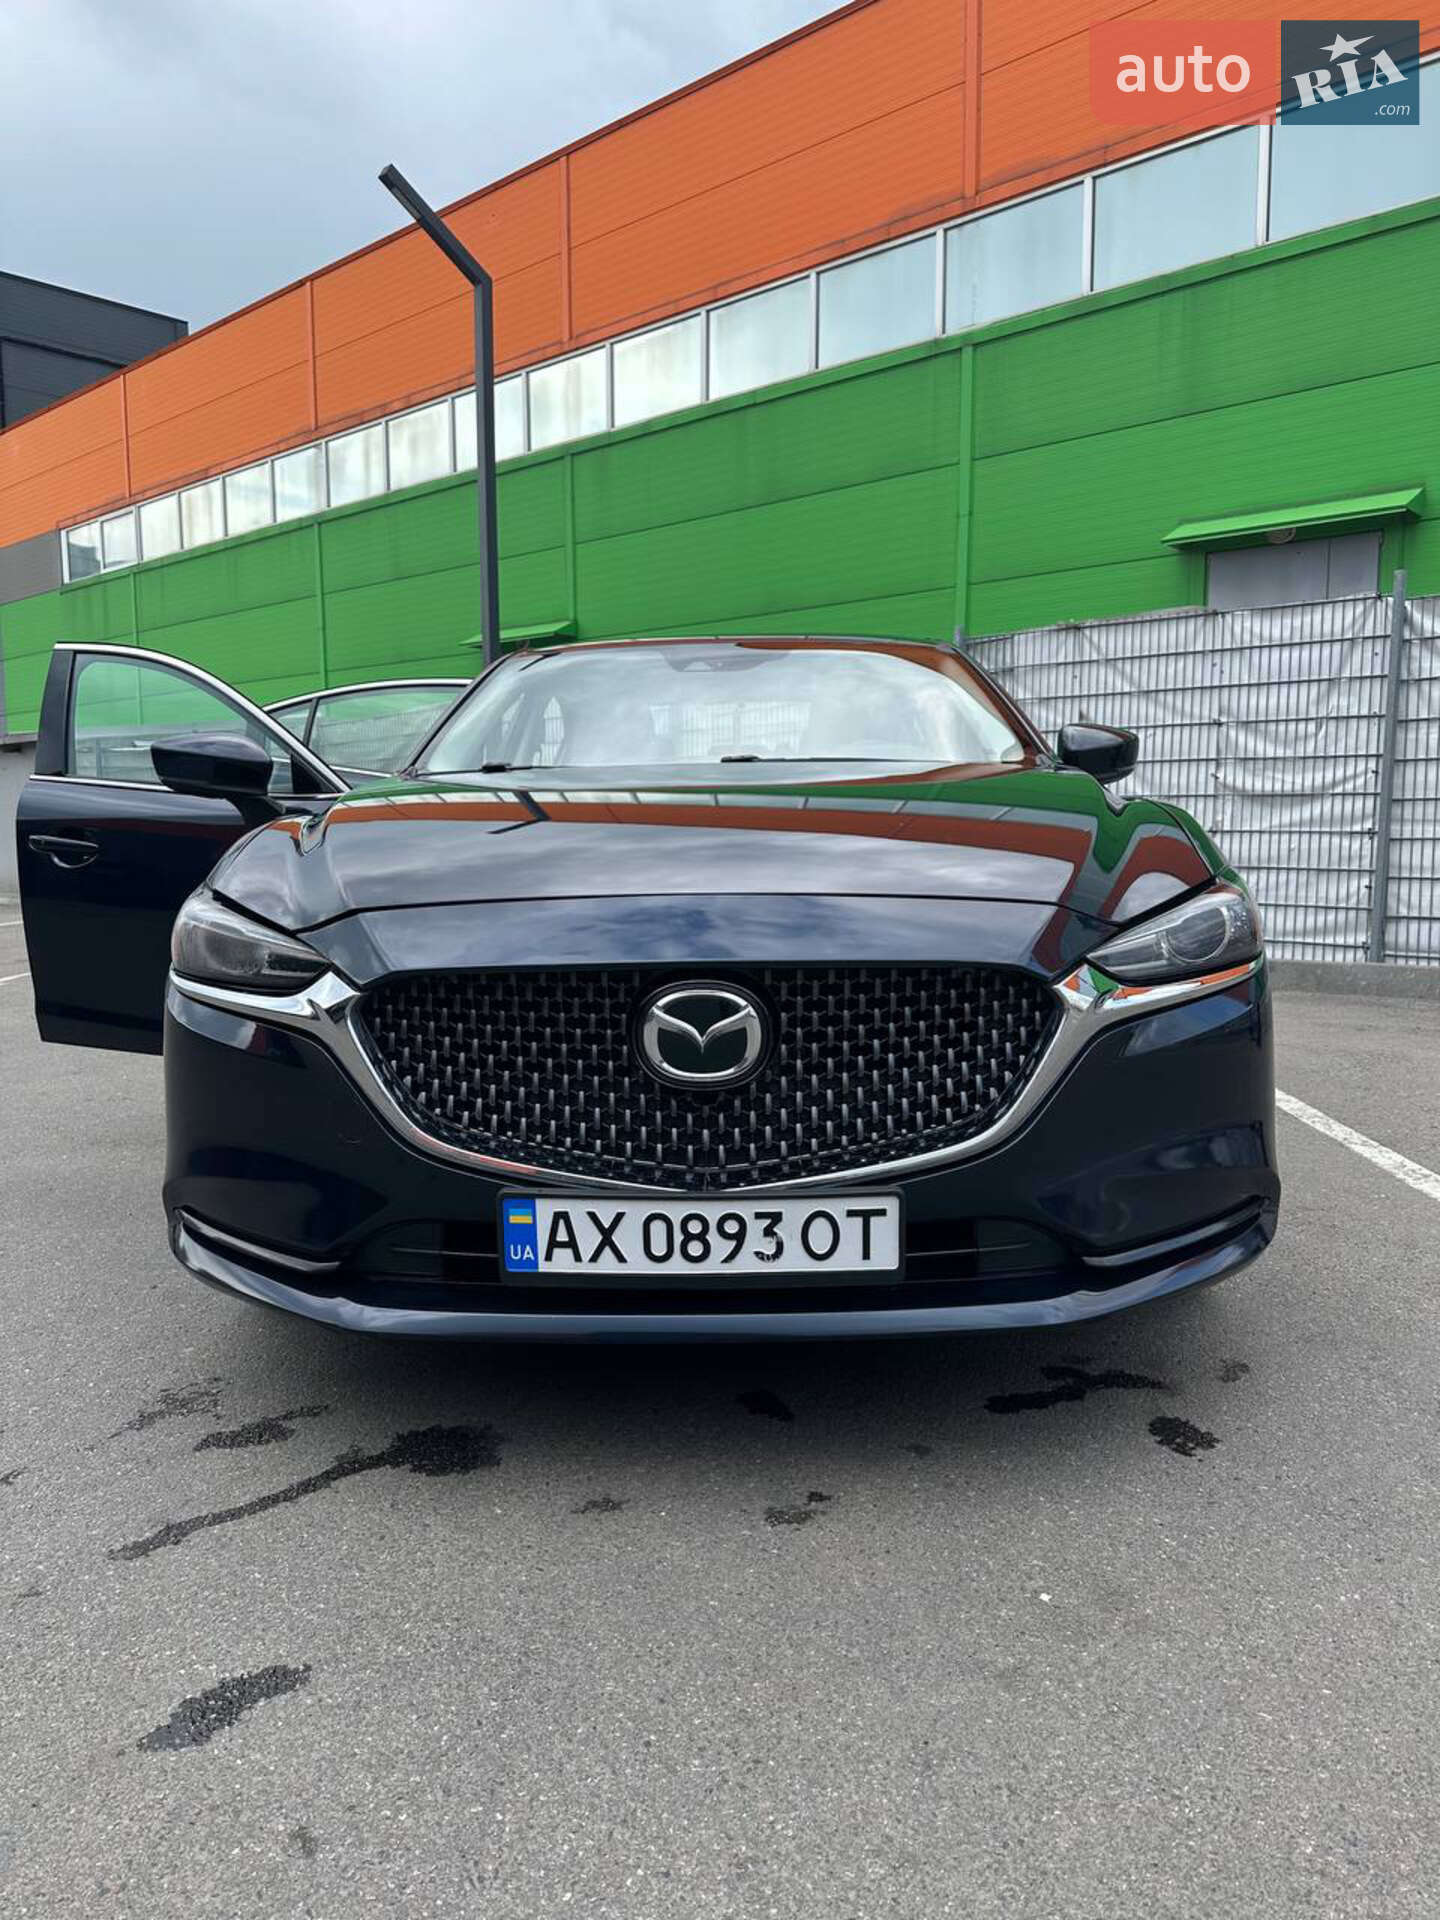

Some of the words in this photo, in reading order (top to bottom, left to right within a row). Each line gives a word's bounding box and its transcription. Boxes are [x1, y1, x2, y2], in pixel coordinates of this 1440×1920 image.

[509, 1245, 535, 1261] UA
[544, 1210, 628, 1263] AX
[642, 1211, 784, 1264] 0893
[801, 1208, 888, 1262] OT
